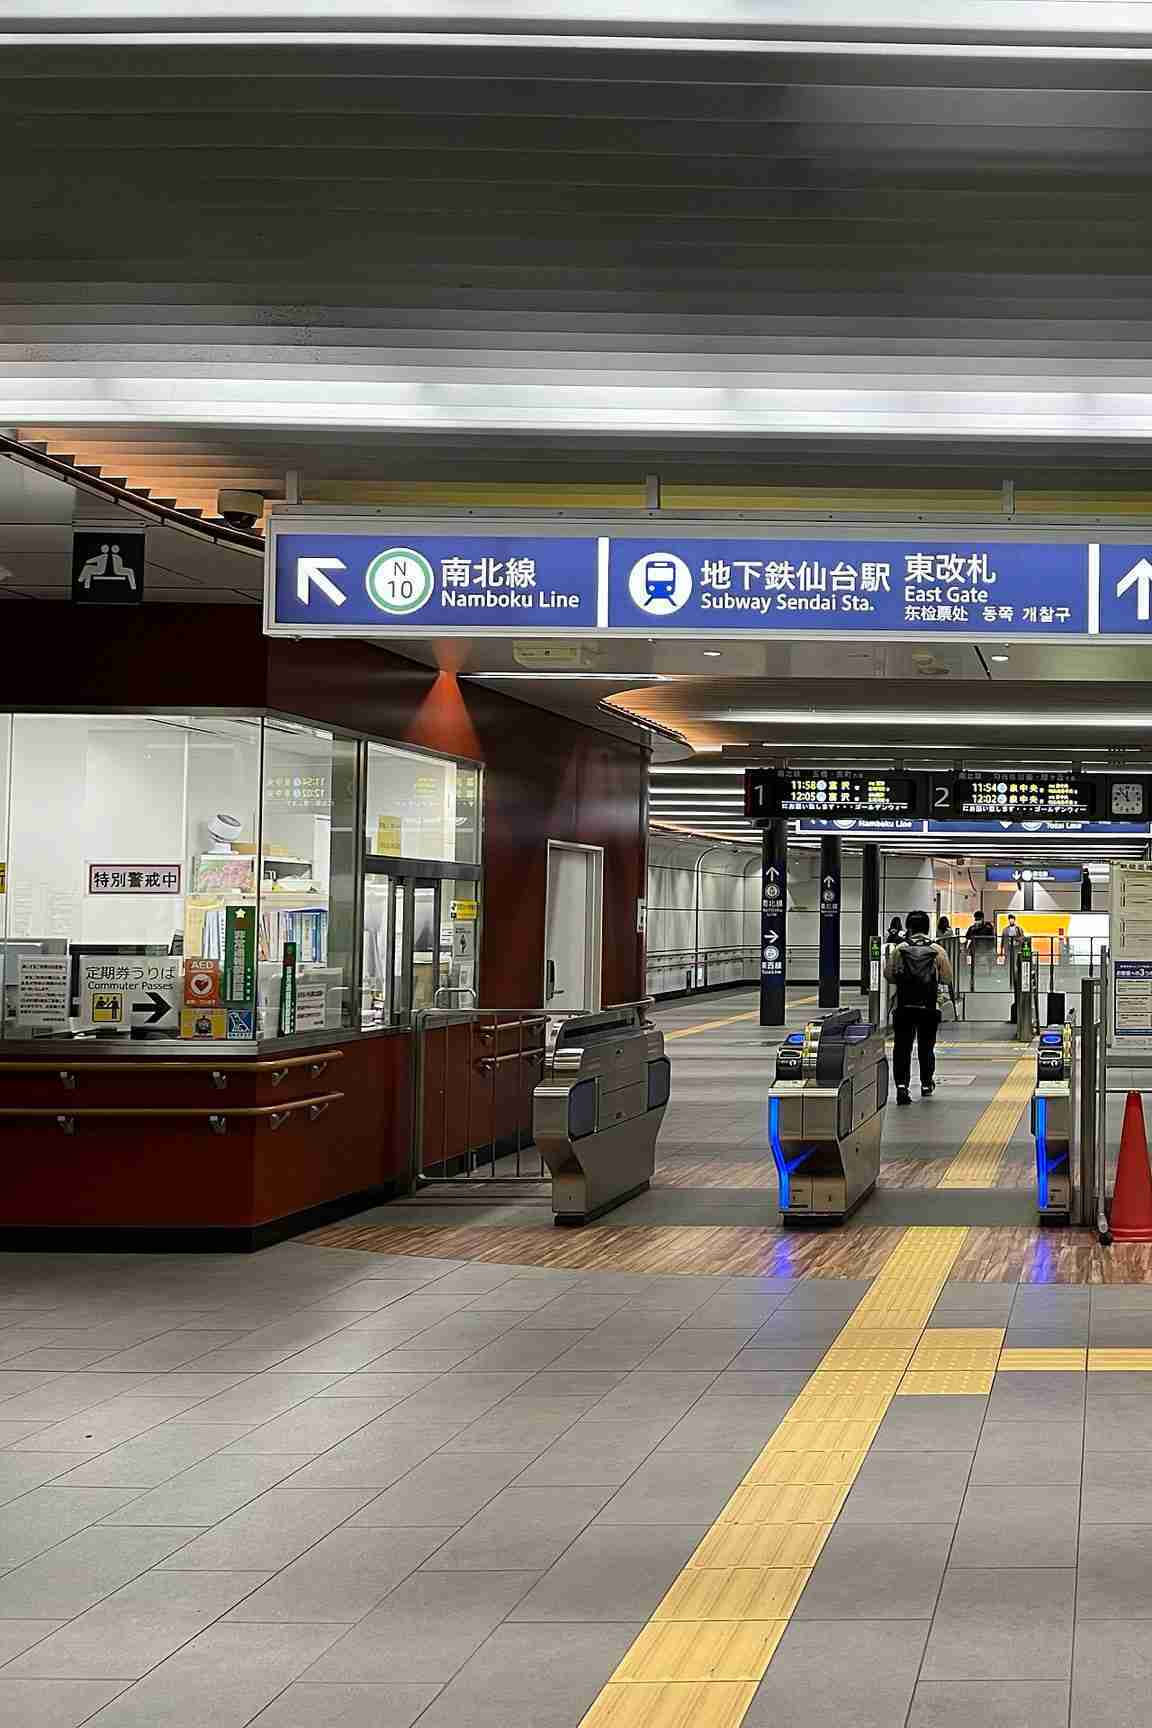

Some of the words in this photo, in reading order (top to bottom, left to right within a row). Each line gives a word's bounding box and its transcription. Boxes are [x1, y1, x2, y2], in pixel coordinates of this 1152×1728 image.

[393, 561, 406, 576] N
[440, 557, 537, 589] 南北線
[700, 560, 891, 592] 地下鉄仙台駅
[904, 553, 996, 584] 東改札
[388, 580, 413, 599] 10
[904, 586, 942, 602] East
[947, 586, 988, 603] Gate
[441, 590, 533, 608] Namboku
[539, 591, 580, 609] Line
[701, 593, 771, 614] Subway
[776, 594, 836, 611] Sendai
[842, 594, 875, 612] Sta.
[982, 606, 1013, 622] 동쪽
[1022, 606, 1071, 623] 개찰구
[790, 780, 817, 790] 11:58
[753, 784, 764, 806] 1
[934, 787, 950, 808] 2
[93, 871, 178, 889] 特別警戒中
[191, 960, 214, 969] AED
[87, 981, 138, 991] Commuter
[141, 981, 174, 991] Passes
